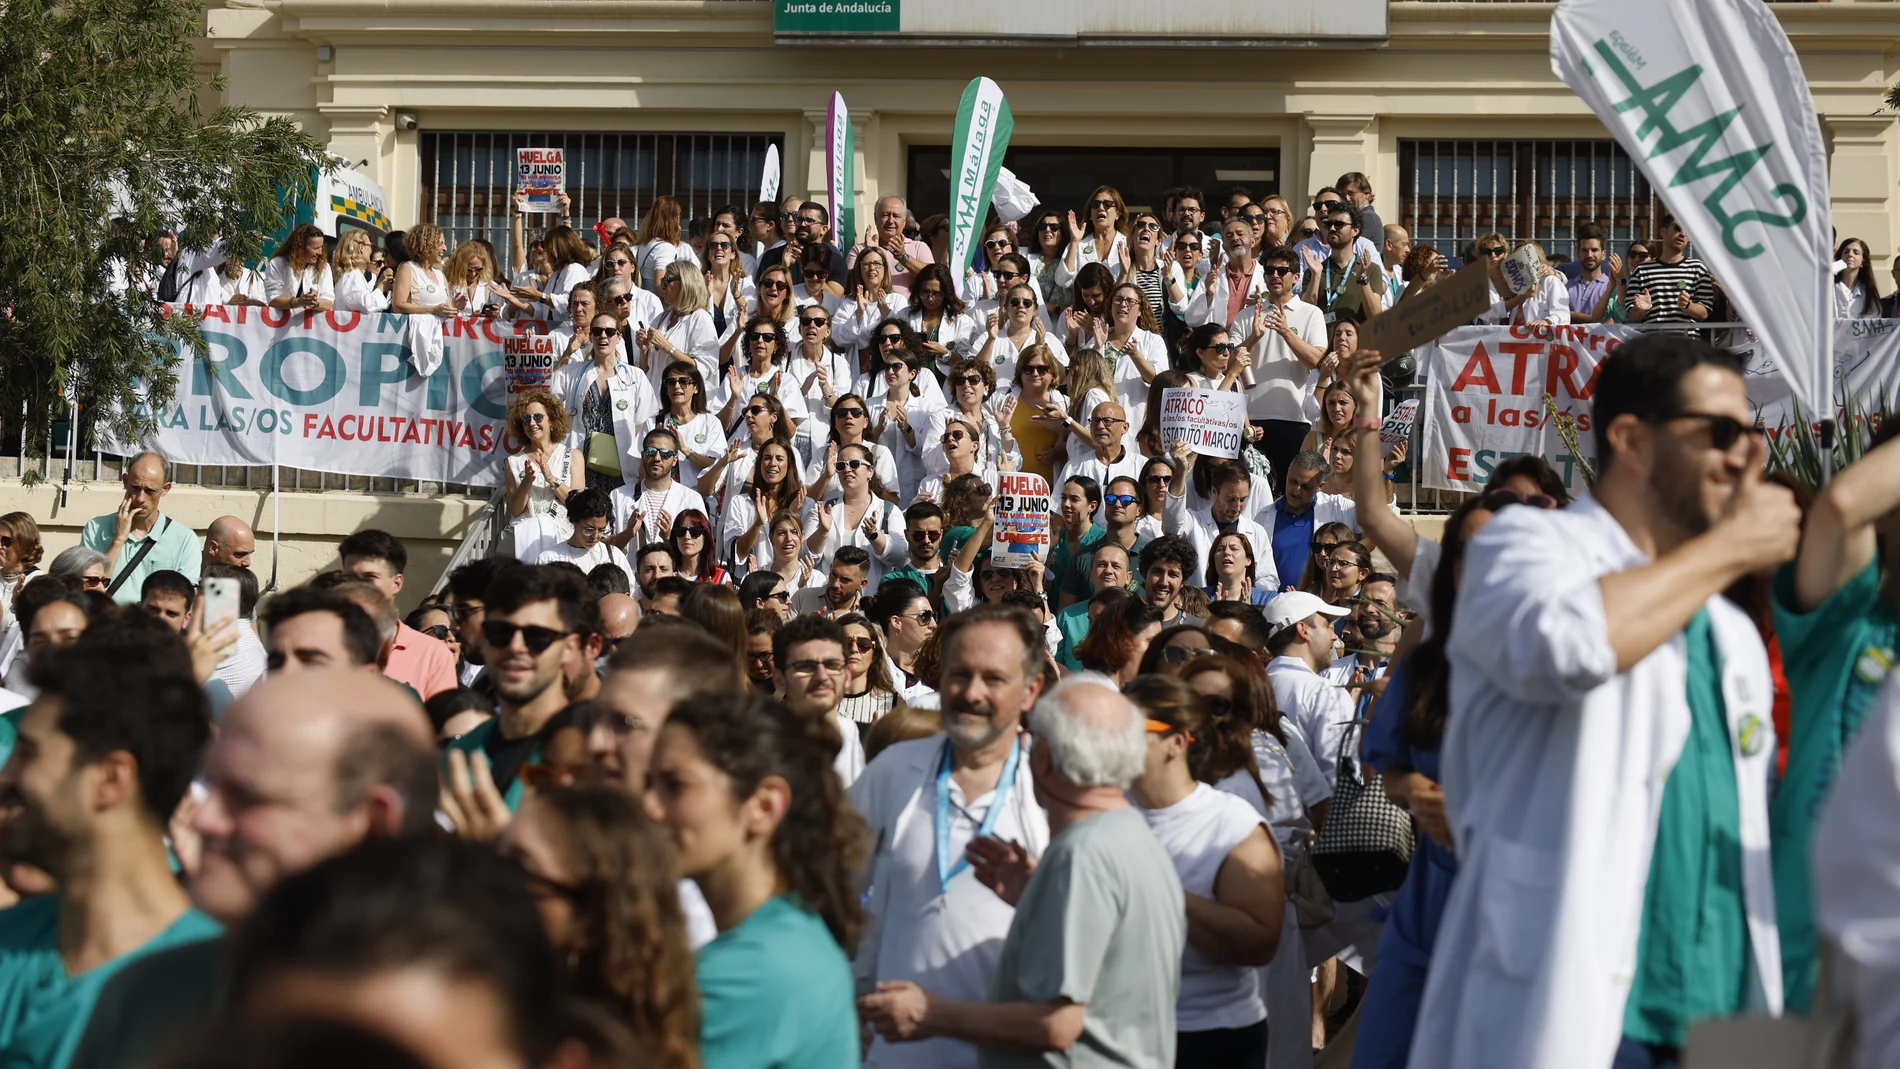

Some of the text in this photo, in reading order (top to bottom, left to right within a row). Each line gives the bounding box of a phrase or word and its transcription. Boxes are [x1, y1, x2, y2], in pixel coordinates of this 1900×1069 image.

[784, 1, 891, 13] Junta de Andalucía
[964, 99, 990, 188] Málaga
[519, 151, 562, 163] HUELGA
[520, 164, 562, 175] 13 JUNIO
[504, 338, 553, 354] HUELGA
[505, 355, 552, 368] 13 JUNIO
[1164, 398, 1204, 415] ATRACO
[1452, 405, 1471, 423] a
[199, 404, 292, 436] LAS/OS
[1167, 414, 1186, 422] las/os
[1187, 415, 1238, 429] facultativas/os
[1163, 427, 1238, 451] ESTATUTO MARCO
[1000, 476, 1049, 496] HUELGA
[1000, 496, 1049, 513] 13 JUNIO
[996, 529, 1048, 545] ÚNETE
